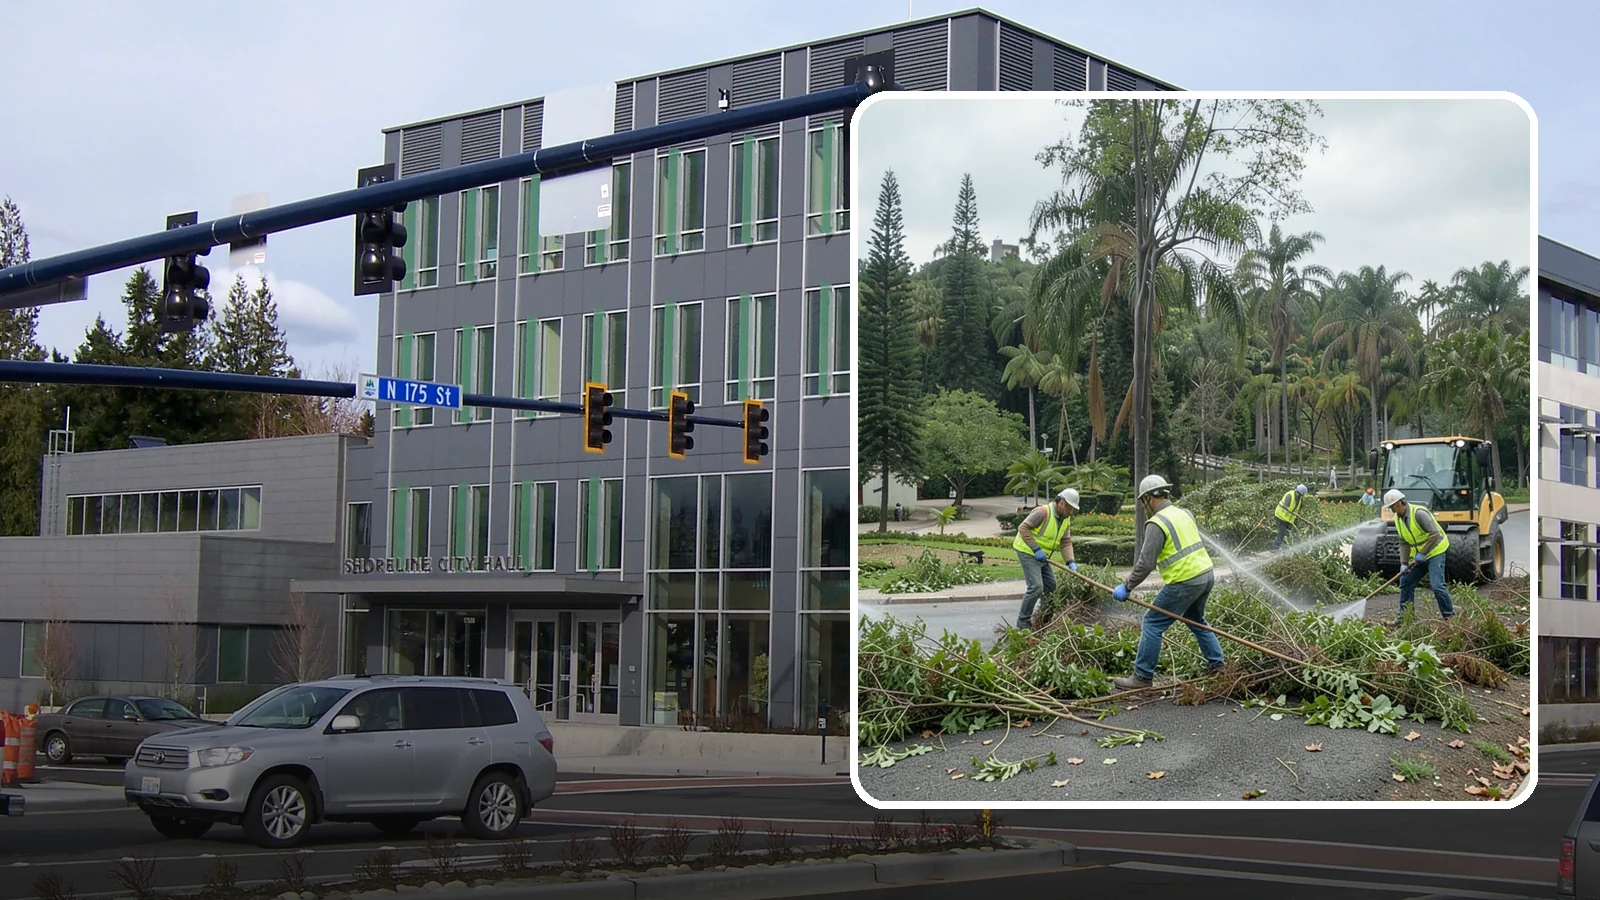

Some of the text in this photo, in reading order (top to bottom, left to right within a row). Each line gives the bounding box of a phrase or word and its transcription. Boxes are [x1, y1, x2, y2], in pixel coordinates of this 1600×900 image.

[387, 380, 451, 406] N 175 St
[344, 556, 525, 574] SHORELINE CITY HALL
